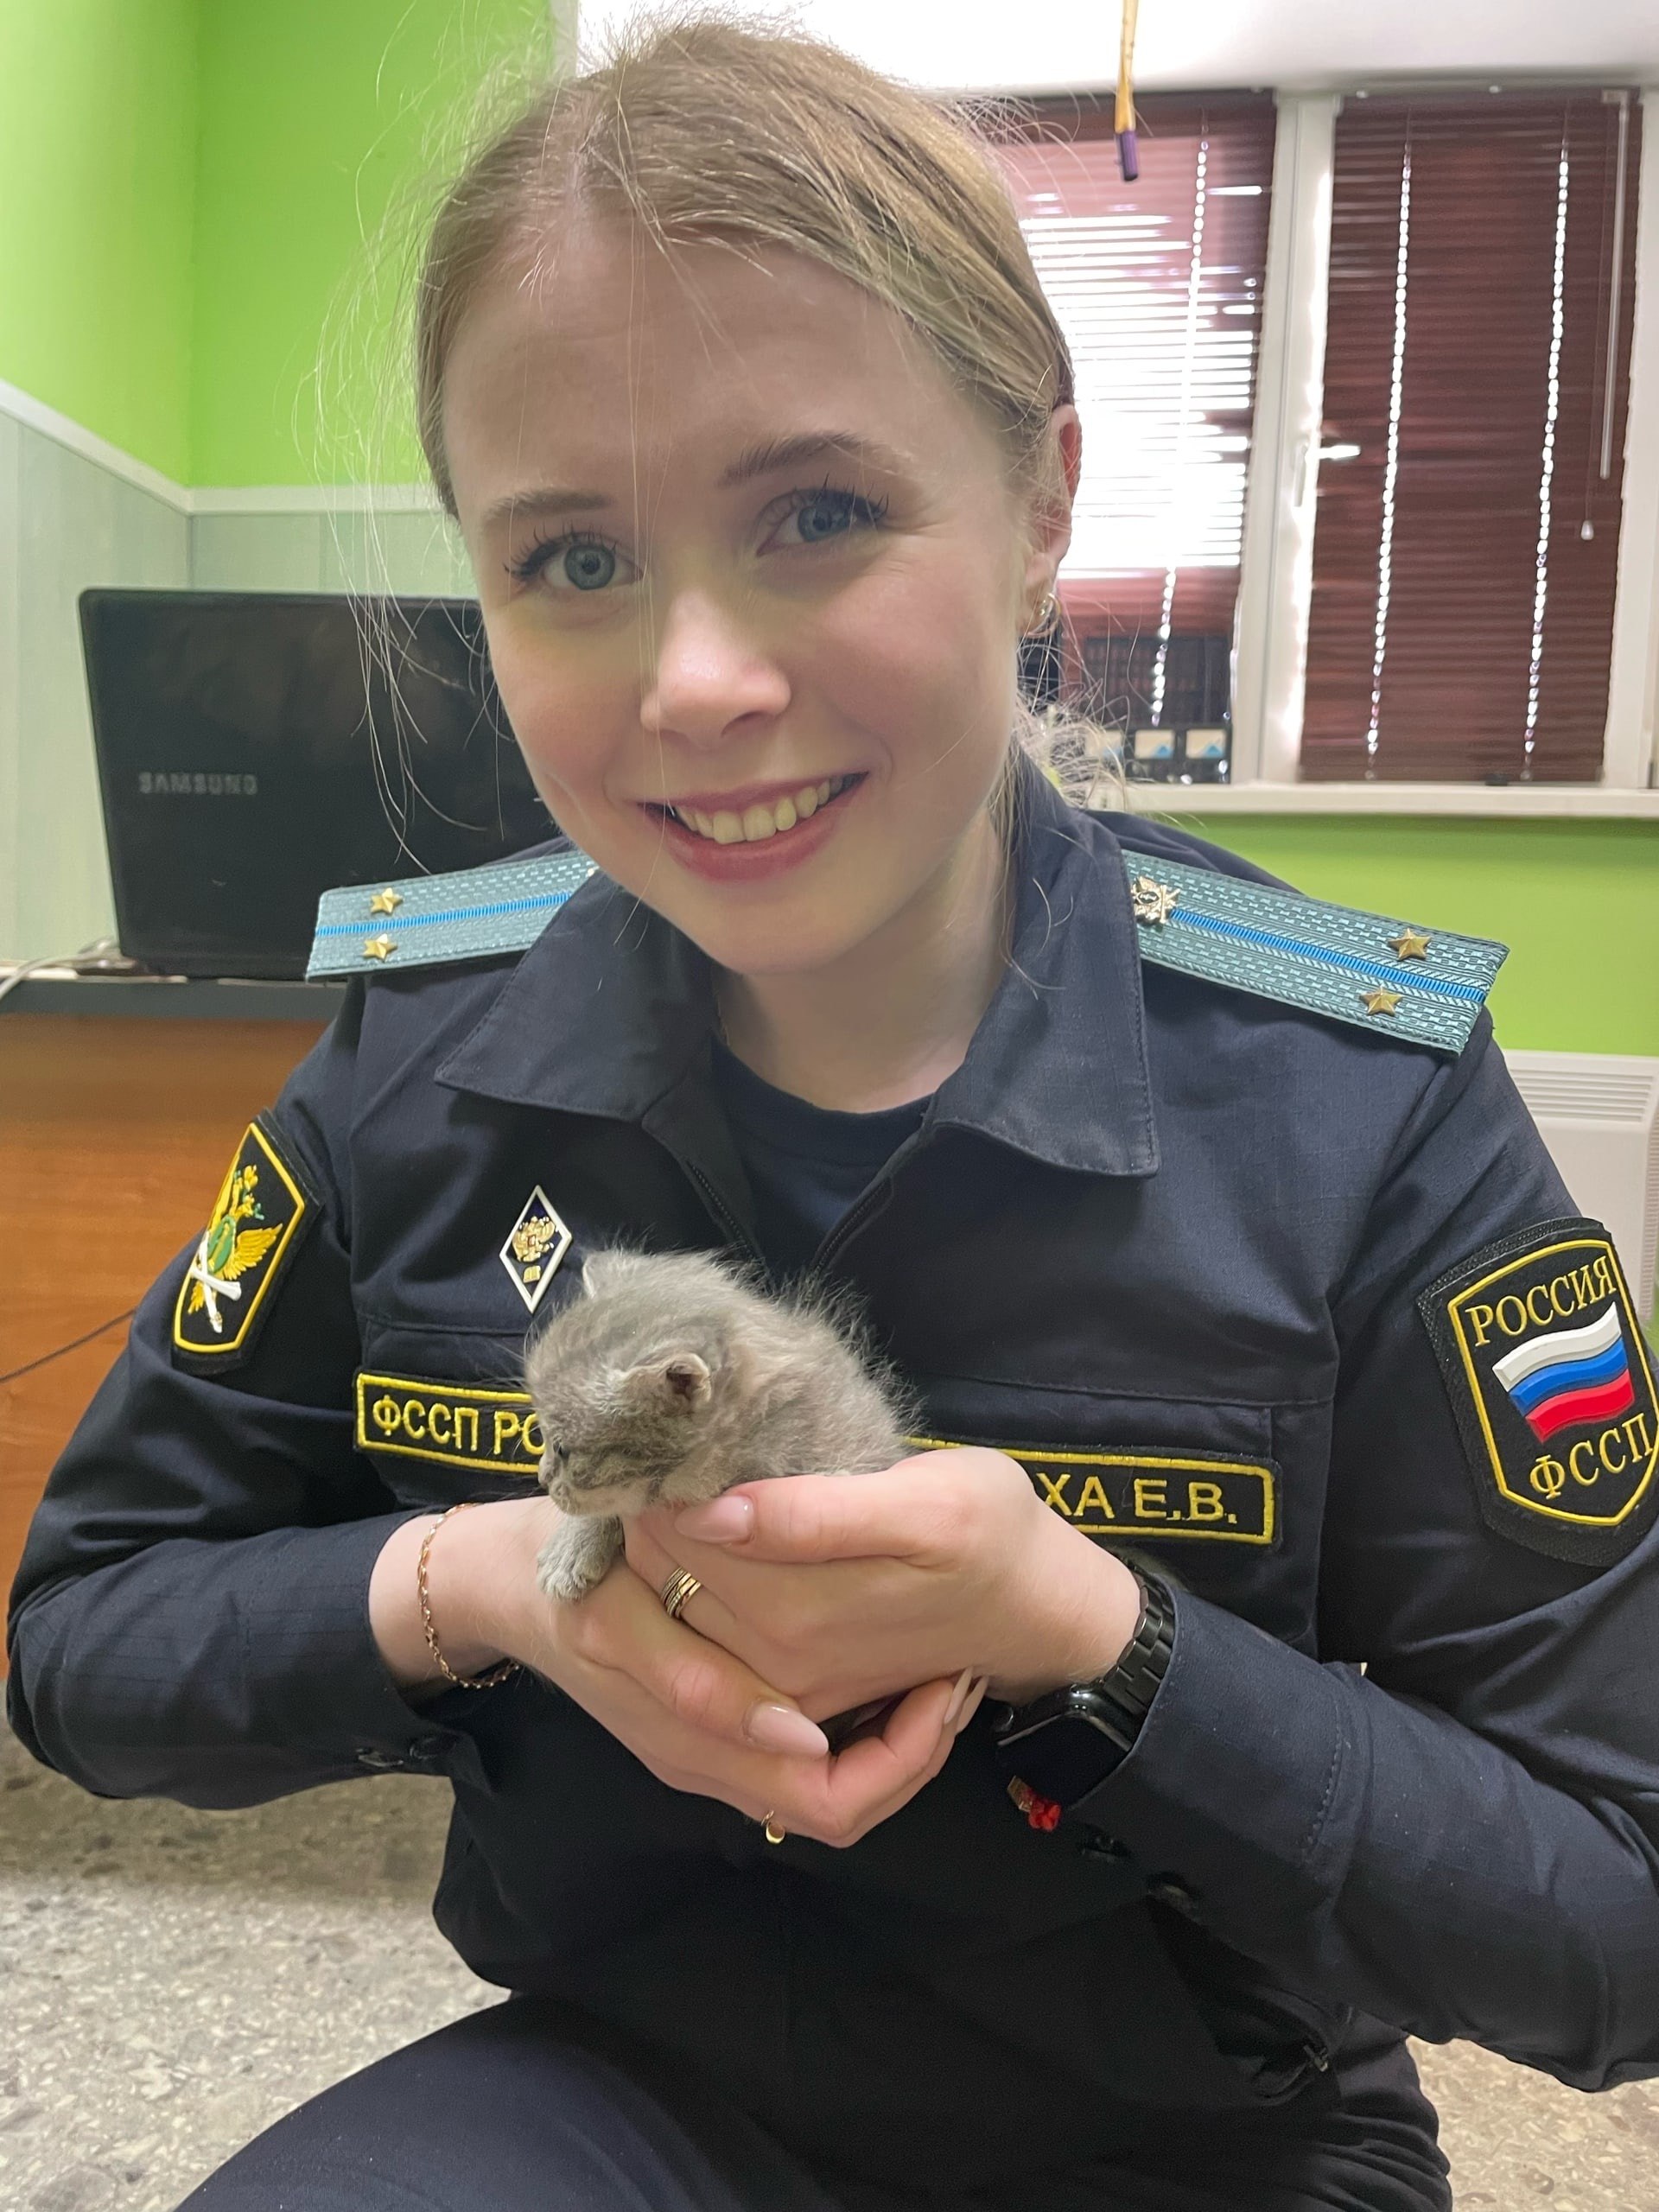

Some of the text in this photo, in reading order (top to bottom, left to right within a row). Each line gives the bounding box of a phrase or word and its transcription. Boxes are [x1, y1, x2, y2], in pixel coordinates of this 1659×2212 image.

[138, 772, 258, 796] SAMSUNG
[1465, 1255, 1617, 1347] РОССИЯ
[372, 1395, 546, 1455] ФССП РО
[1529, 1413, 1654, 1500] ФССП
[1036, 1471, 1237, 1524] ХА Е.В.
